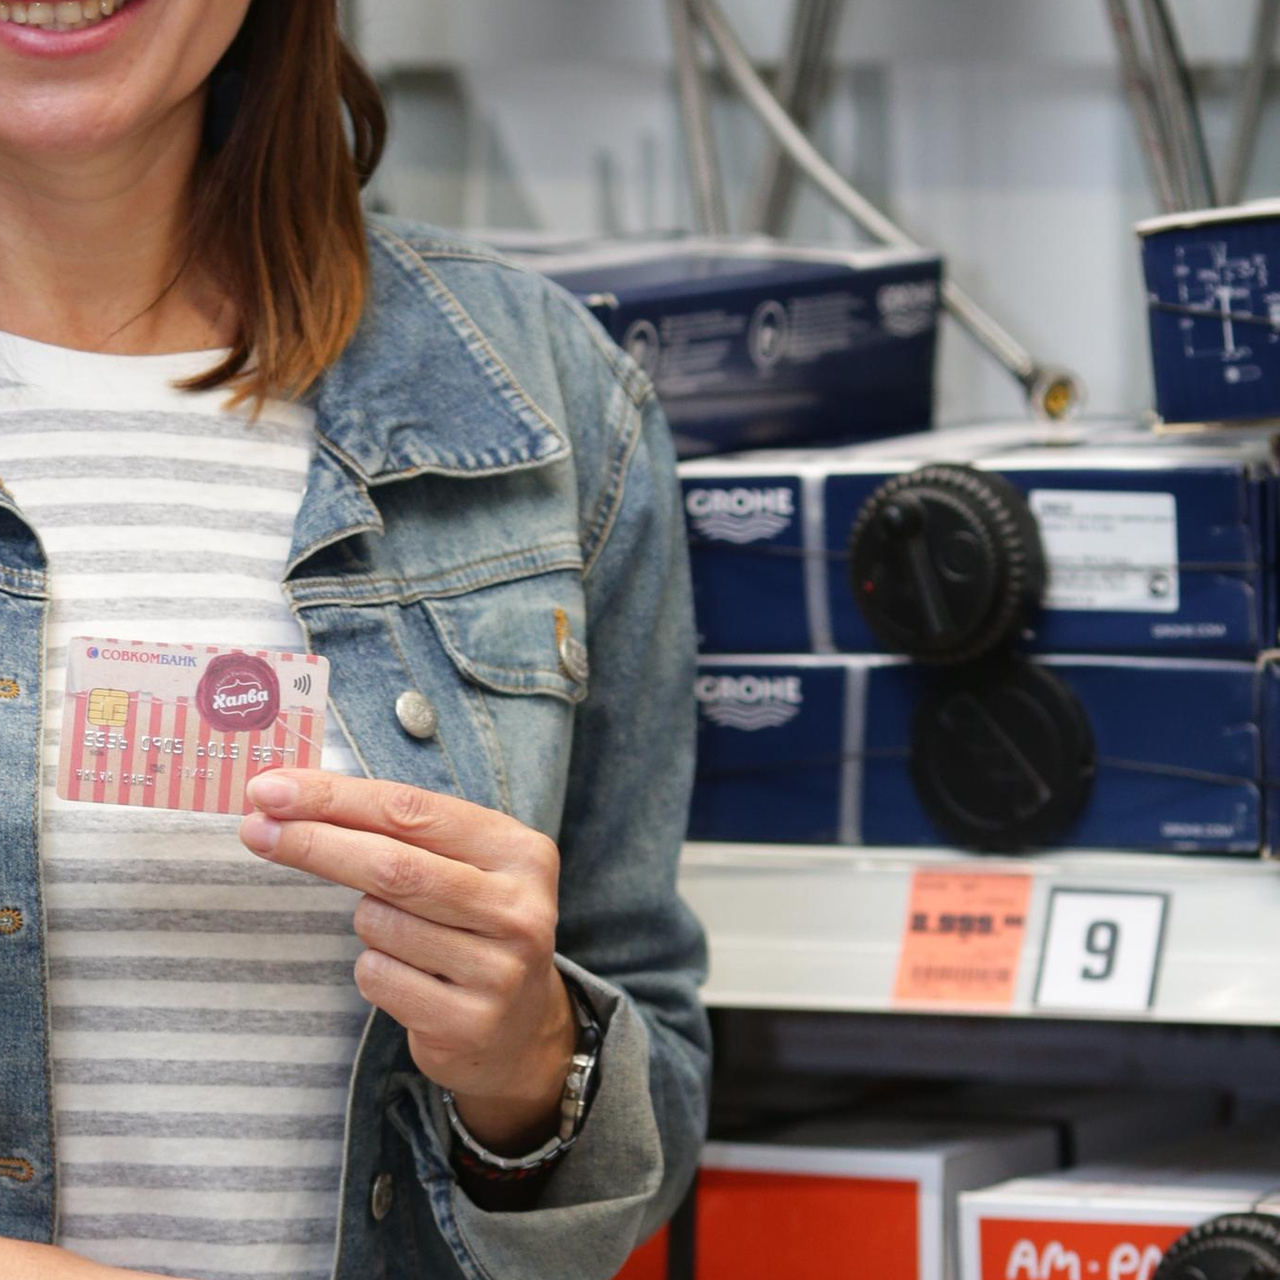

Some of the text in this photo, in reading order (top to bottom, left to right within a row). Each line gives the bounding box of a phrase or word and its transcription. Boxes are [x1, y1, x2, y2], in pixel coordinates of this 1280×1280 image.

[686, 488, 794, 516] GROHE
[101, 649, 197, 667] СОВКОМБАНК
[212, 689, 269, 710] Халва
[1081, 920, 1120, 981] 9
